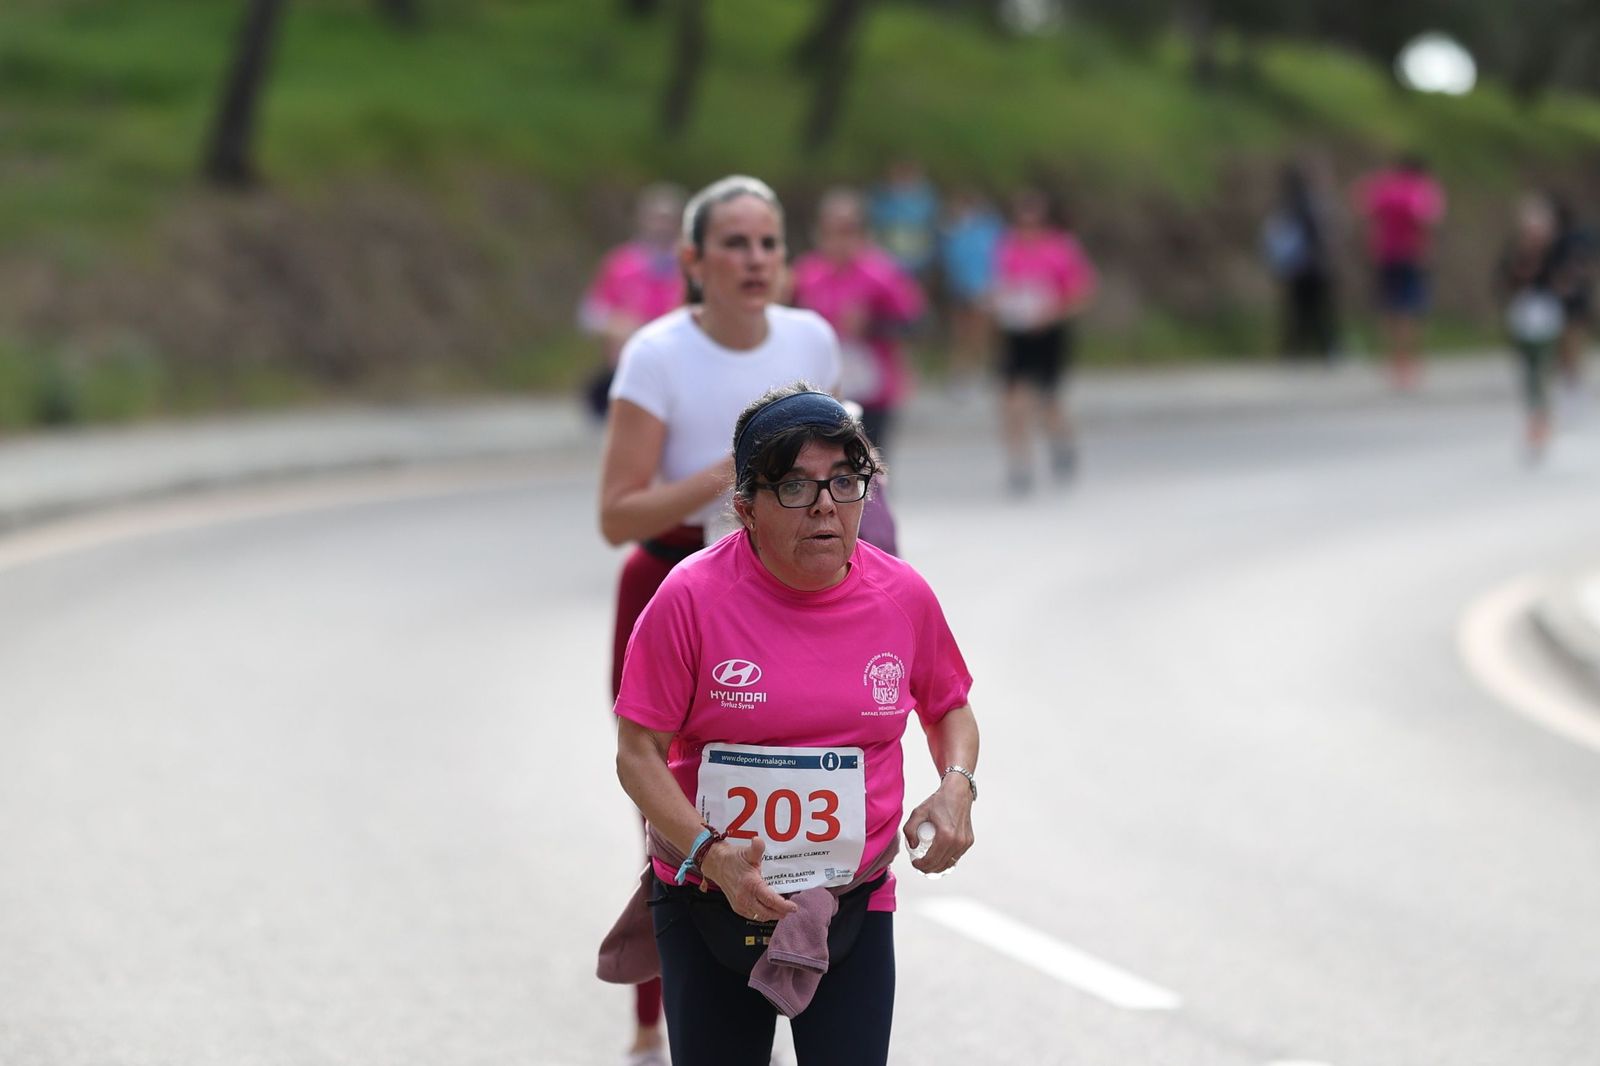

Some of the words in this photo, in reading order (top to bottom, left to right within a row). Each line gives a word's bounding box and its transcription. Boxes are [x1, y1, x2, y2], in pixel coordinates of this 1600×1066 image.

[710, 690, 767, 702] HYUNDAI
[738, 702, 755, 710] Syrsa
[721, 754, 796, 767] www.deporte.malaga.eu
[726, 787, 841, 843] 203
